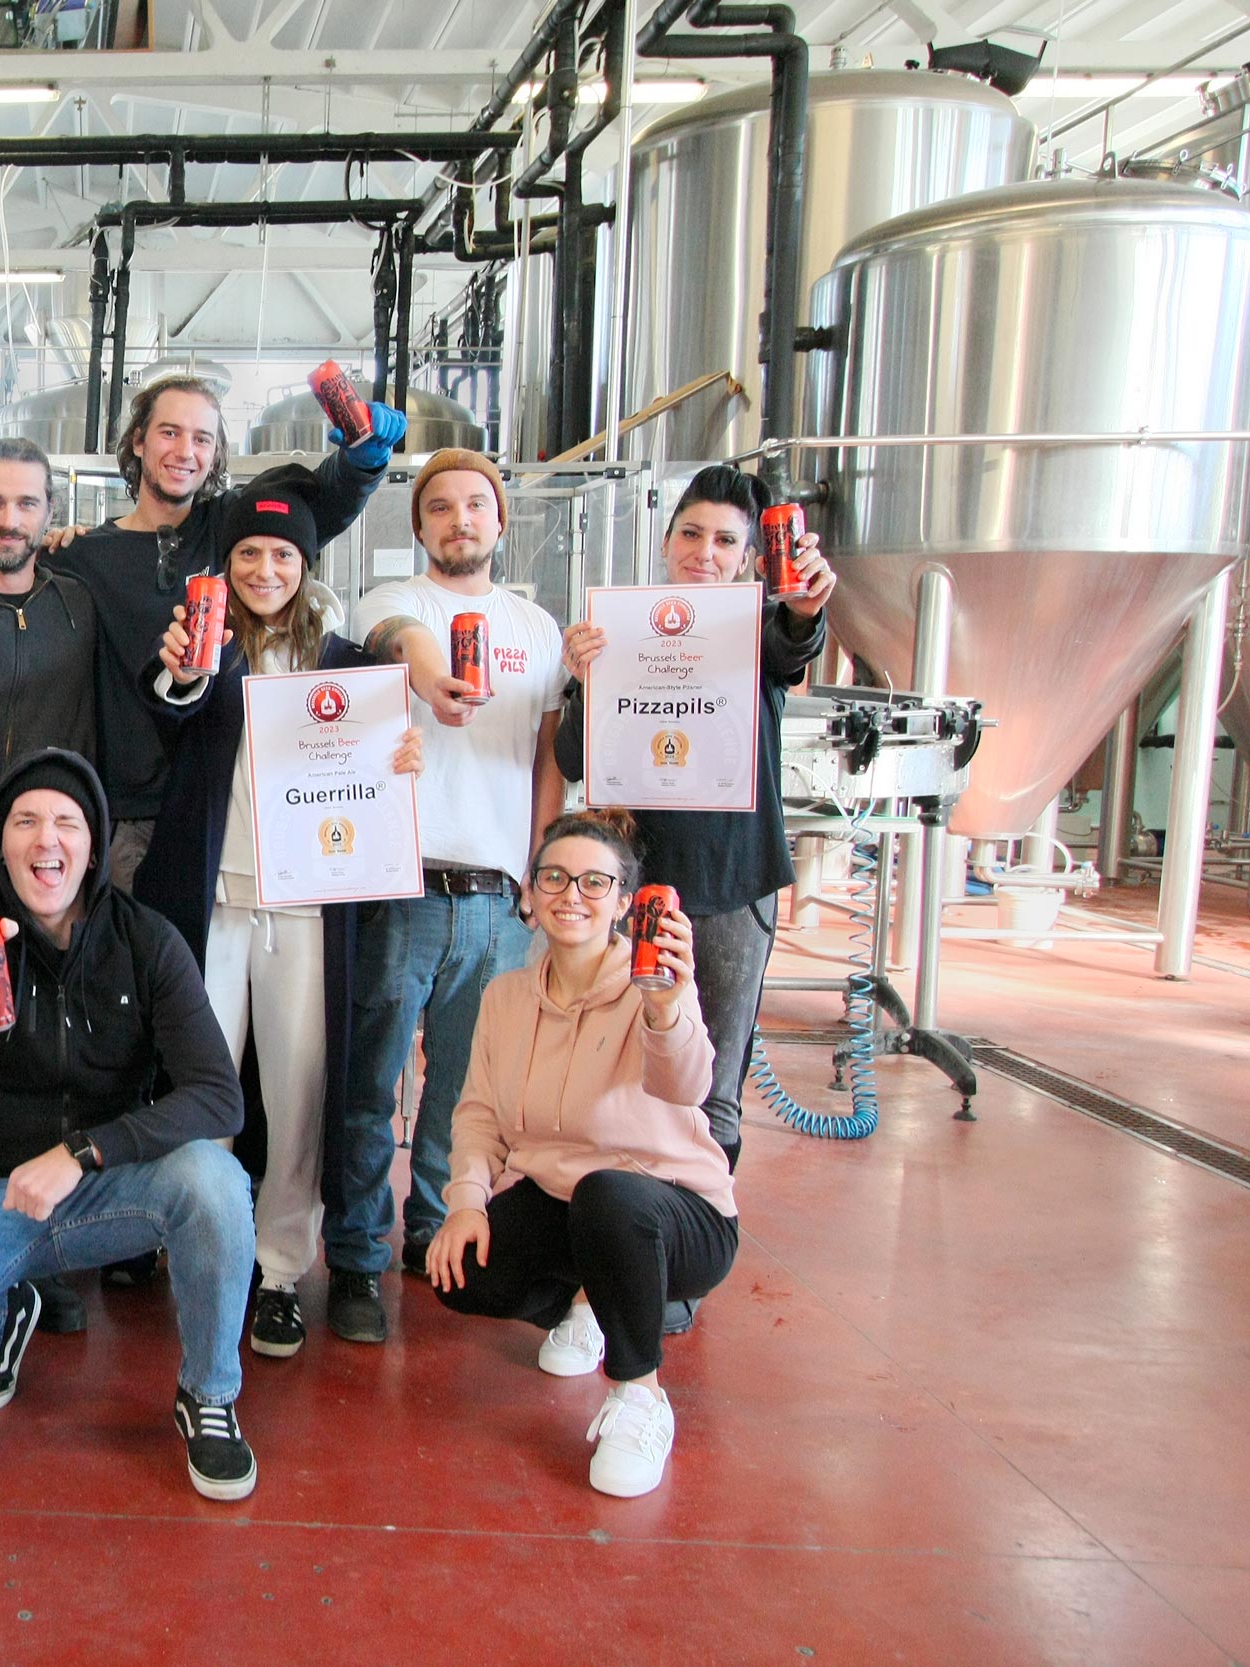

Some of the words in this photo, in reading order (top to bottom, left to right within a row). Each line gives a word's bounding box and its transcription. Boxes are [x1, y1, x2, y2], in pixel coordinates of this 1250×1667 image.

[660, 640, 682, 648] 2023
[638, 652, 677, 663] Brussels
[679, 652, 703, 662] Beer
[499, 660, 526, 674] PILS
[647, 664, 694, 680] Challenge
[319, 725, 340, 734] 2023
[298, 739, 335, 750] Brussels
[337, 737, 360, 747] Beer
[308, 751, 352, 766] Challenge
